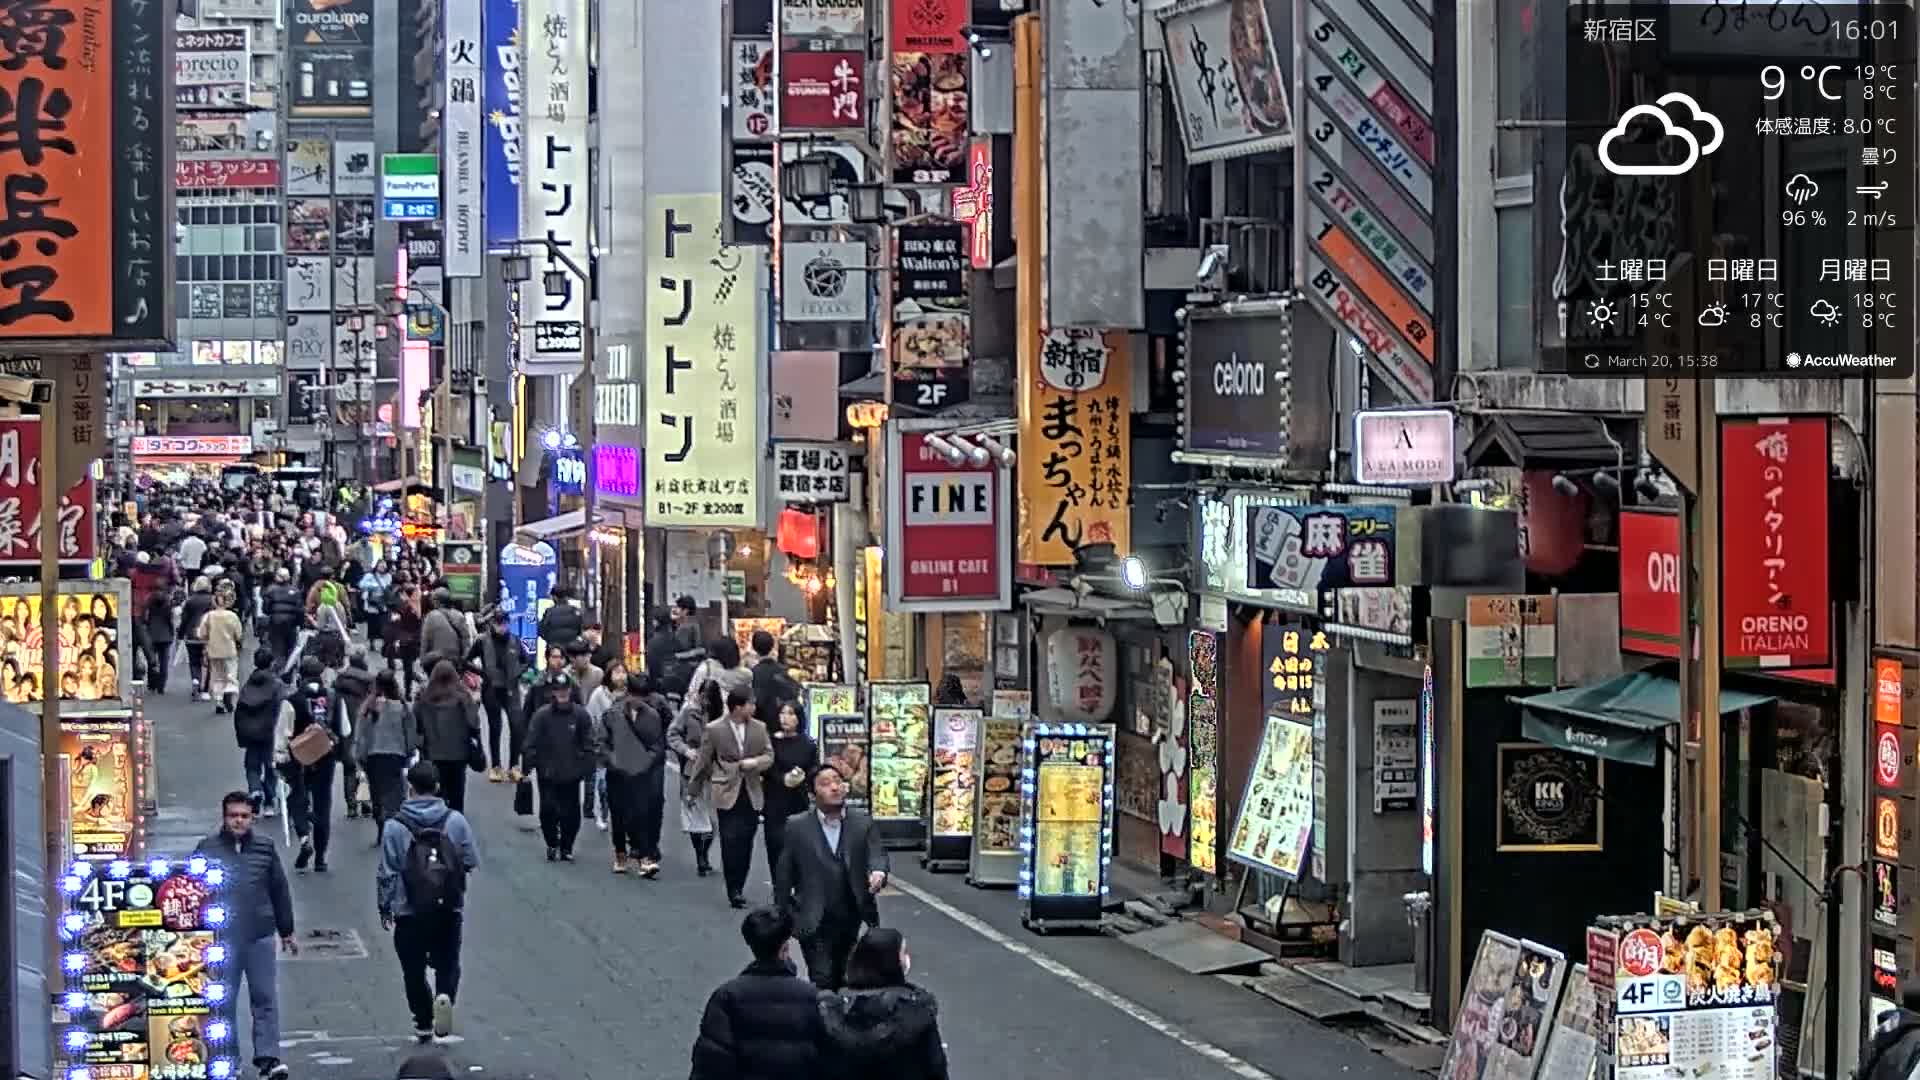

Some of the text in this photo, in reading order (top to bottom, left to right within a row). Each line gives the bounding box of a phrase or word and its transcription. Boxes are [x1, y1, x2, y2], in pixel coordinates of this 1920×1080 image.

[296, 12, 368, 25] auralume
[1315, 22, 1336, 43] 5
[451, 40, 475, 103] 火鍋
[831, 59, 859, 120] 牛門
[1315, 75, 1333, 91] 4
[1315, 122, 1334, 142] 3
[1314, 172, 1334, 193] 2
[540, 135, 572, 311] トントン
[902, 255, 961, 272] Walton's
[660, 208, 693, 463] トントン
[1044, 339, 1103, 374] 新宿
[712, 325, 738, 443] 焼とん酒場
[1213, 352, 1265, 396] celona
[917, 385, 947, 405] 2F
[780, 450, 844, 471] 酒場心
[1041, 395, 1087, 549] まっちゃん
[780, 475, 845, 493] 新宿本店
[912, 484, 987, 514] FINE
[1351, 519, 1392, 536] フリー
[1755, 431, 1789, 604] 俺のイタリアン
[911, 559, 989, 574] ONLINE CAFE
[1742, 615, 1809, 633] ORENO
[1740, 634, 1809, 652] ITALIAN
[1535, 782, 1564, 800] KK
[80, 877, 126, 911] 4F
[1622, 982, 1655, 1004] 4F
